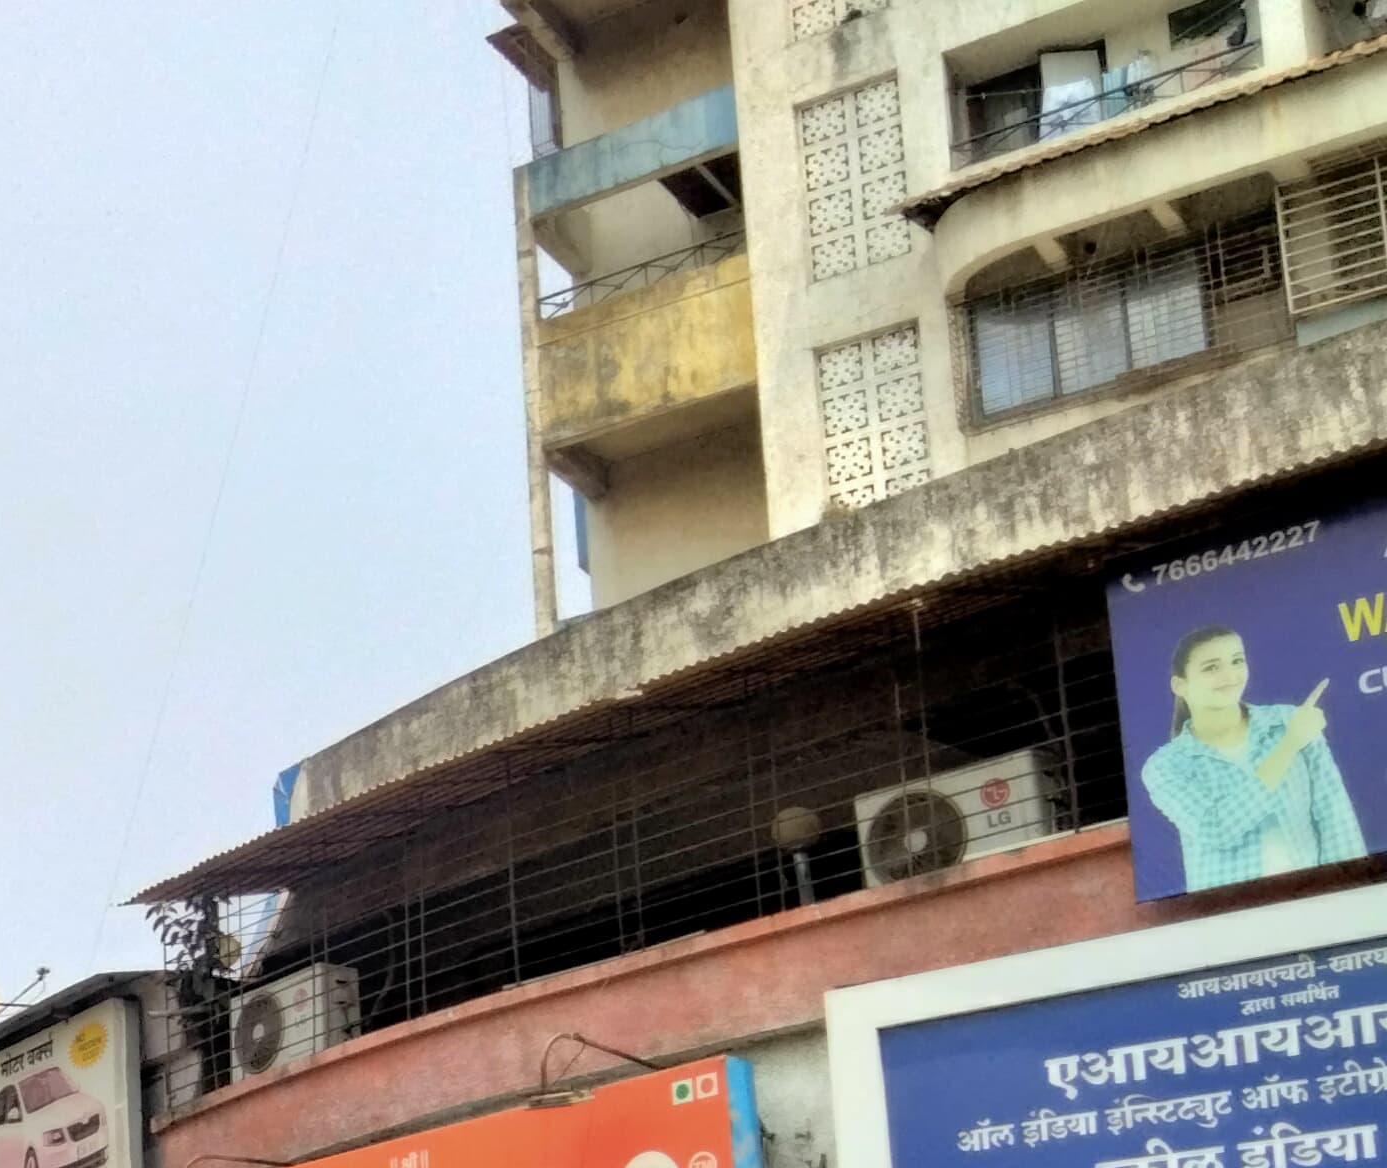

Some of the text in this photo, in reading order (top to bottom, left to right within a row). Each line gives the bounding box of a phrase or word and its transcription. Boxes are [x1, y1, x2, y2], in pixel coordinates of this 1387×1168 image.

[1152, 520, 1321, 585] 7666442227
[1338, 592, 1387, 641] W
[987, 811, 1011, 828] LG
[1281, 981, 1340, 1007] समर्थित
[957, 1118, 1015, 1151] ऑल
[1021, 1108, 1098, 1148] इंडिया
[1242, 1074, 1309, 1109] ऑफ
